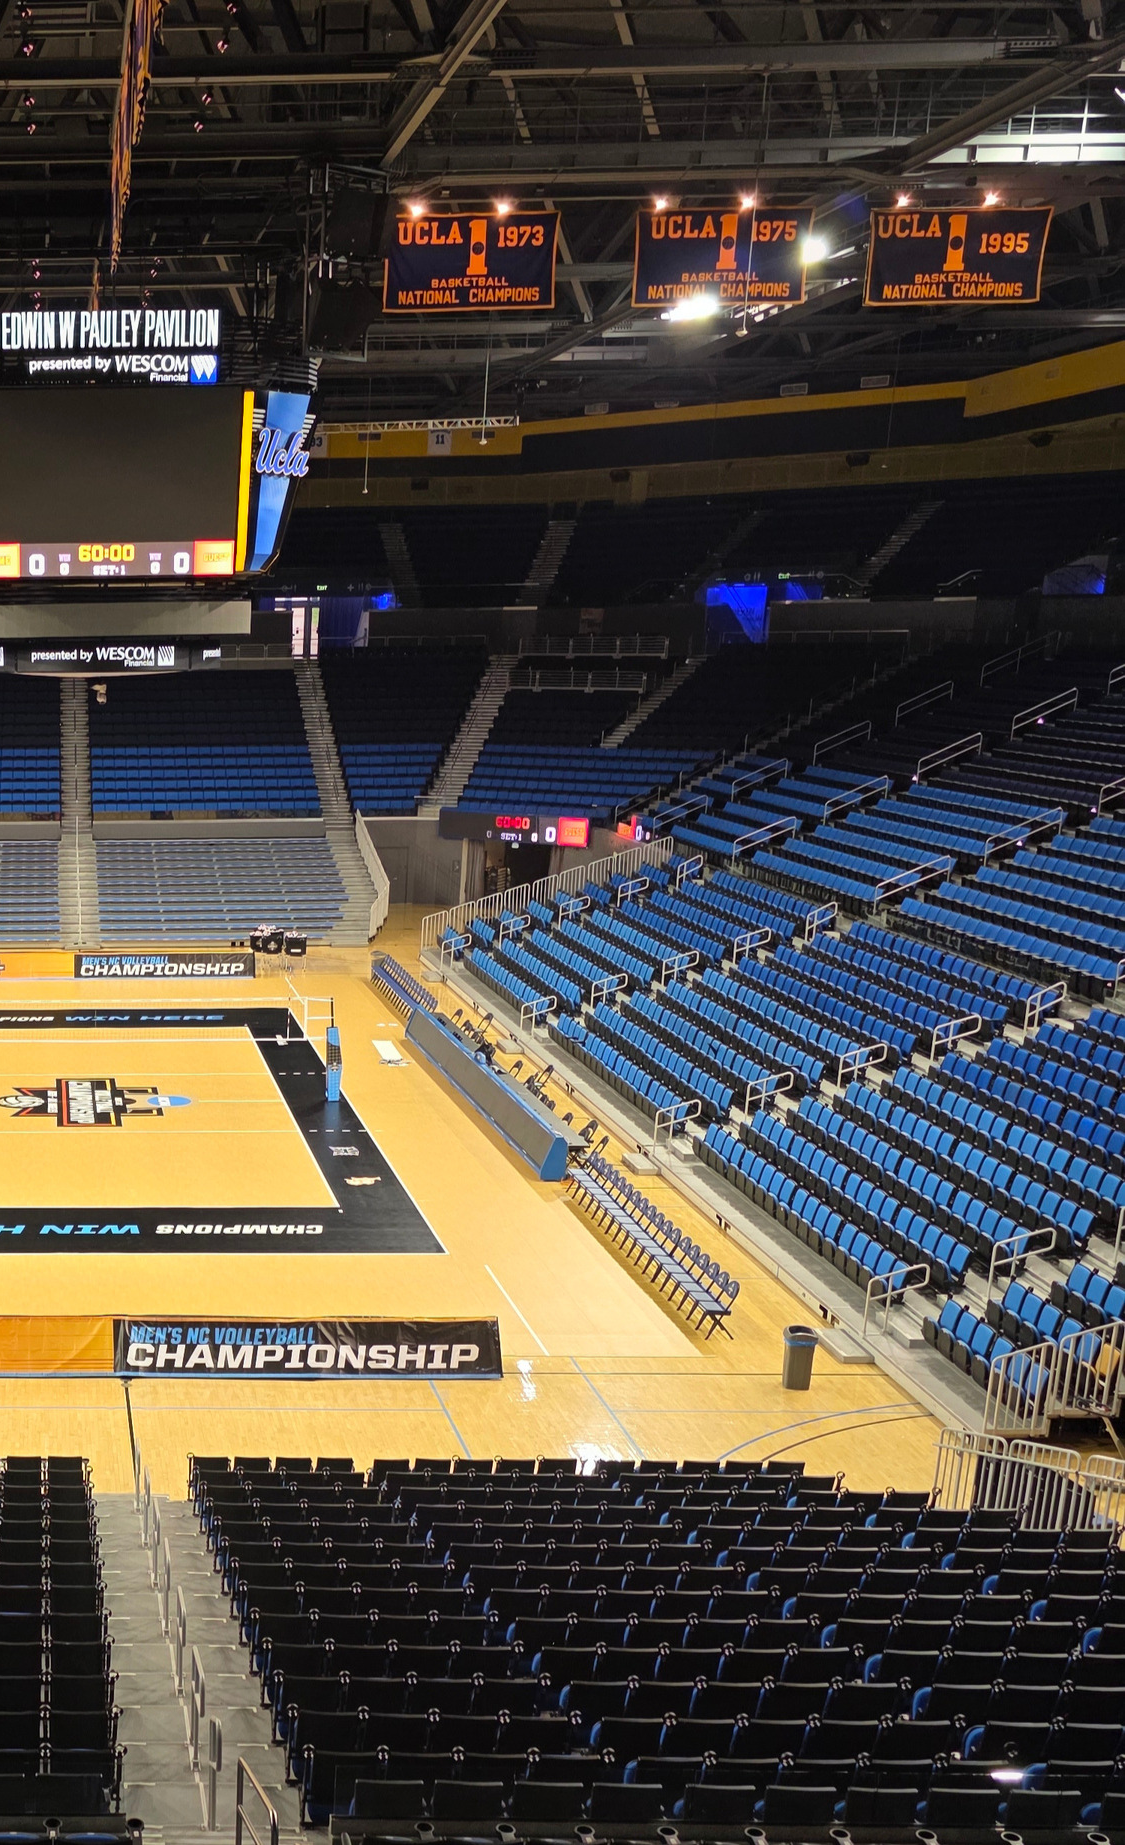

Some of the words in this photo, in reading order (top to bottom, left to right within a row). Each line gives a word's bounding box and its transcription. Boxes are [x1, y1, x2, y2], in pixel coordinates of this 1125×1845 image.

[498, 225, 544, 247] 1973
[752, 221, 797, 241] 1975
[398, 221, 463, 245] UCLA
[466, 220, 487, 275] 1
[651, 215, 716, 239] UCLA
[716, 214, 738, 269] 1
[878, 214, 941, 238] UCLA
[943, 215, 968, 271] 1
[979, 233, 1029, 254] 1995
[431, 277, 508, 289] BASKETBALL
[682, 272, 758, 282] BASKETBALL
[915, 272, 993, 284] BASKETBALL
[398, 290, 459, 305] NATIONAL
[469, 287, 539, 302] CHAMPIONS
[648, 285, 706, 299] NATIONAL
[720, 282, 789, 297] CHAMPIONS
[883, 284, 946, 299] NATIONAL
[952, 283, 1022, 297] CHAMPIONS
[2, 312, 55, 349] EDWIN
[59, 312, 76, 349] W
[80, 310, 142, 348] PAULEY
[145, 309, 219, 348] PAVILION
[29, 357, 91, 374] presented
[95, 356, 111, 372] by
[115, 355, 188, 373] WESCOM
[150, 373, 188, 382] Financial
[436, 434, 444, 444] 11
[78, 544, 135, 562] 60:00
[29, 554, 45, 575] 0
[174, 552, 190, 574] 0
[31, 650, 77, 663] presented
[80, 651, 93, 663] by
[96, 647, 154, 661] WESCOM
[496, 816, 530, 830] 60:00
[545, 827, 556, 842] 0
[82, 957, 107, 965] MEN'S
[122, 956, 169, 964] VOLLEYBALL
[80, 963, 244, 976] CHAMPIONSHIP
[39, 1224, 141, 1234] WIN
[155, 1224, 325, 1235] CHAMPIONS
[129, 1327, 181, 1344] MEN'S
[186, 1327, 210, 1345] NC
[215, 1326, 315, 1346] VOLLEYBALL
[126, 1343, 480, 1369] CHAMPIONSHIP
